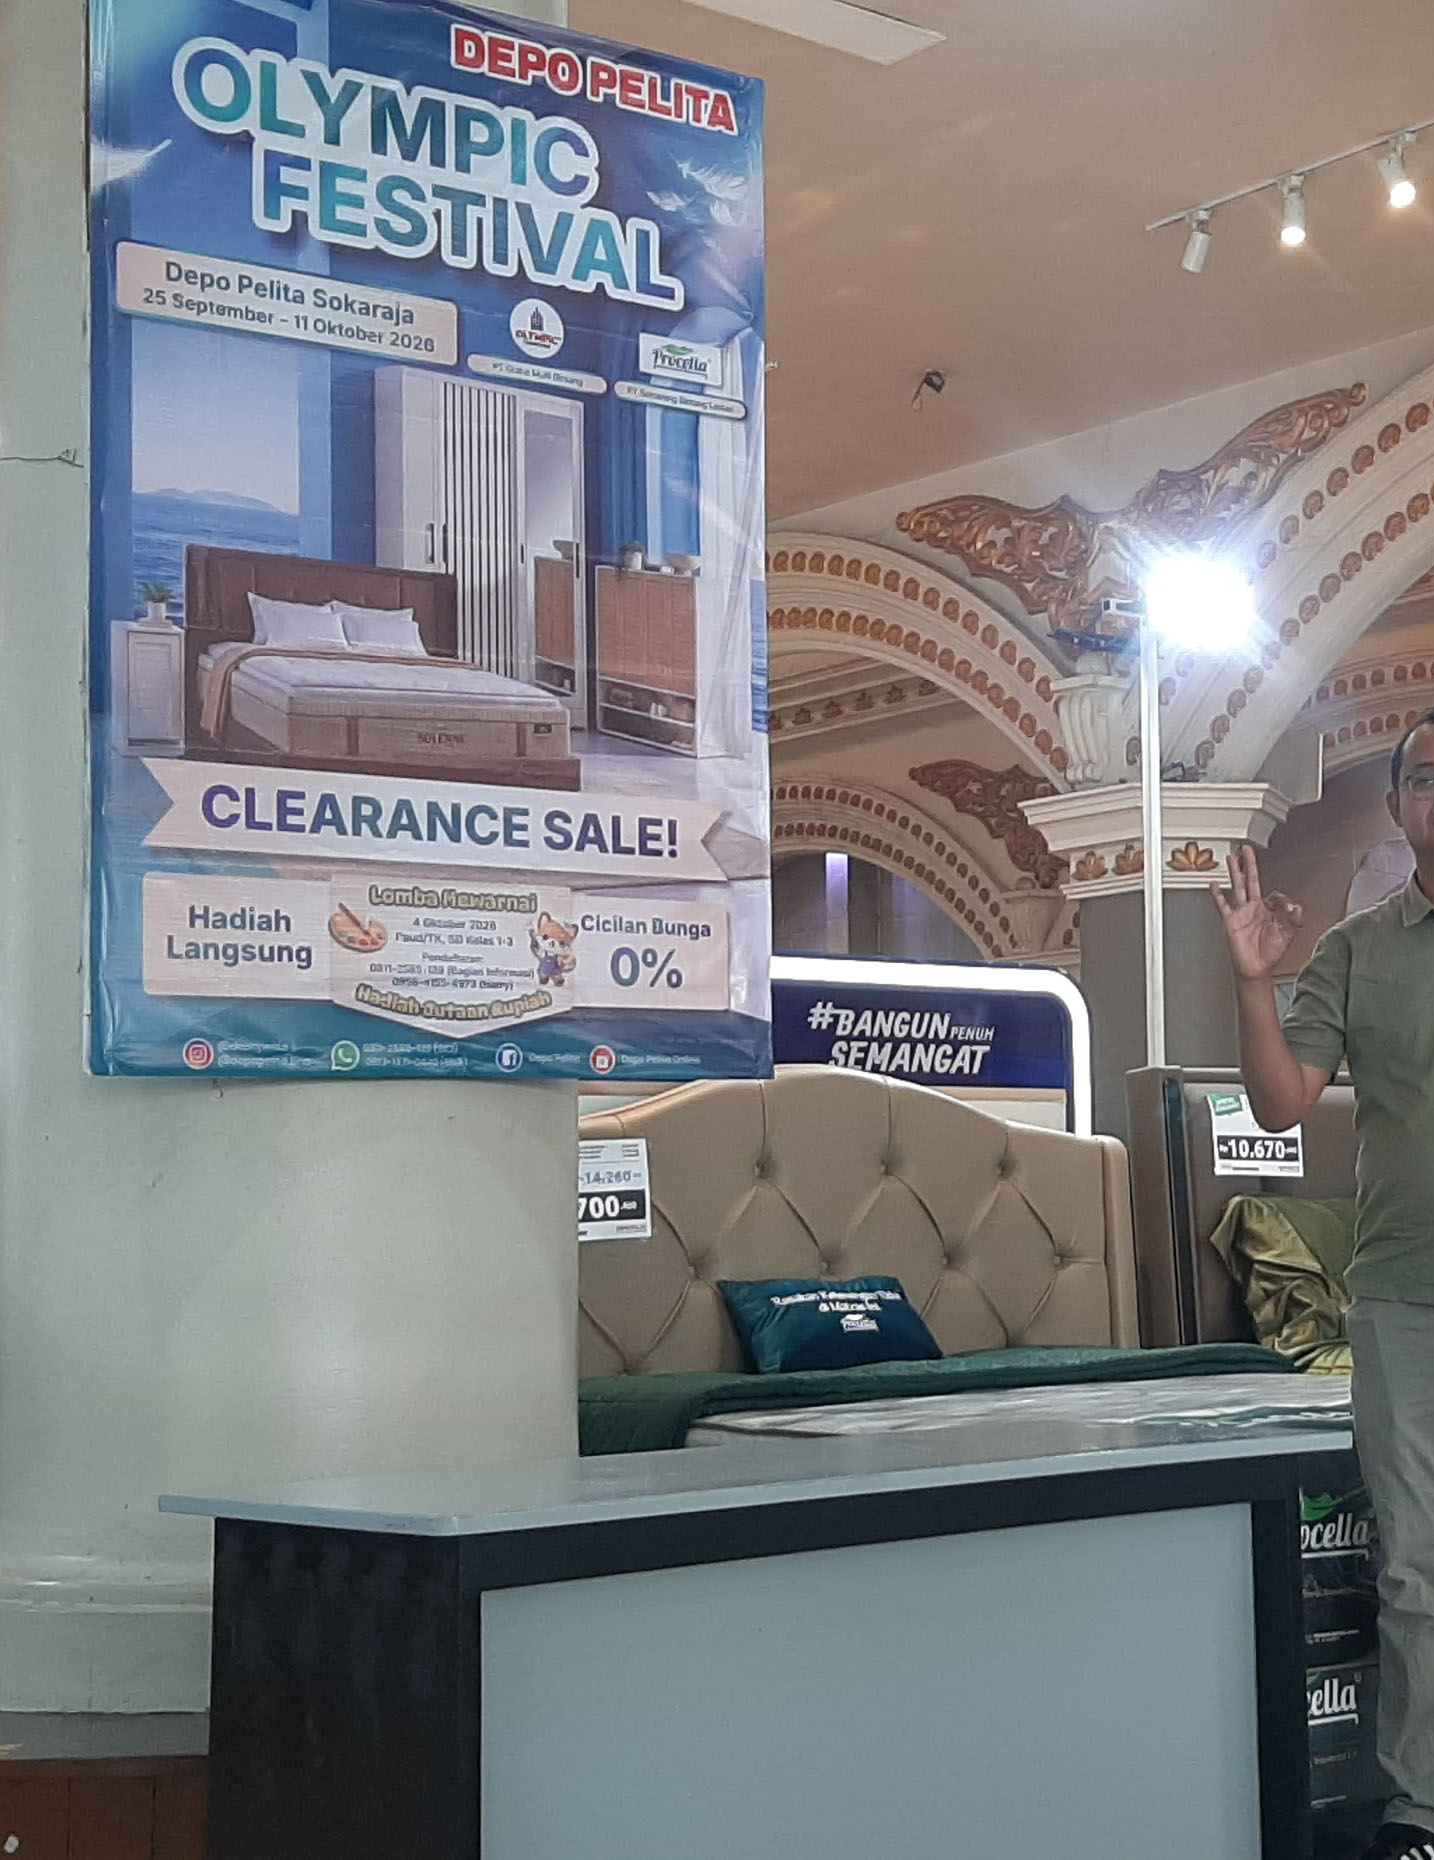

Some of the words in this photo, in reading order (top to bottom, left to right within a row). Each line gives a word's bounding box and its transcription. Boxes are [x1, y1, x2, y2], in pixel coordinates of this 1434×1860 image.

[453, 26, 581, 94] DEPO
[589, 59, 737, 134] PELITA
[181, 47, 593, 197] OLYMPIC
[260, 148, 678, 302] FESTIVAL
[165, 261, 231, 292] Depo
[237, 274, 305, 305] Pelita
[312, 288, 415, 327] Sokaraja
[142, 287, 167, 306] 25
[171, 292, 275, 326] September
[293, 314, 309, 332] 11
[313, 317, 384, 345] Oktober
[651, 348, 708, 372] Procella
[200, 784, 531, 849] CLEARANCE
[543, 813, 680, 858] SALE!
[187, 905, 292, 934] Hadiah
[370, 885, 438, 908] Lomba
[442, 889, 537, 913] Mewarnai
[580, 914, 647, 936] Cicilan
[650, 916, 713, 944] Bunga
[167, 936, 314, 971] Langsung
[608, 947, 684, 990] 0%
[356, 983, 421, 1016] Hadiah
[807, 1001, 951, 1040] #BANGUN
[950, 1026, 996, 1042] PENUH
[829, 1041, 992, 1075] SEMANGAT
